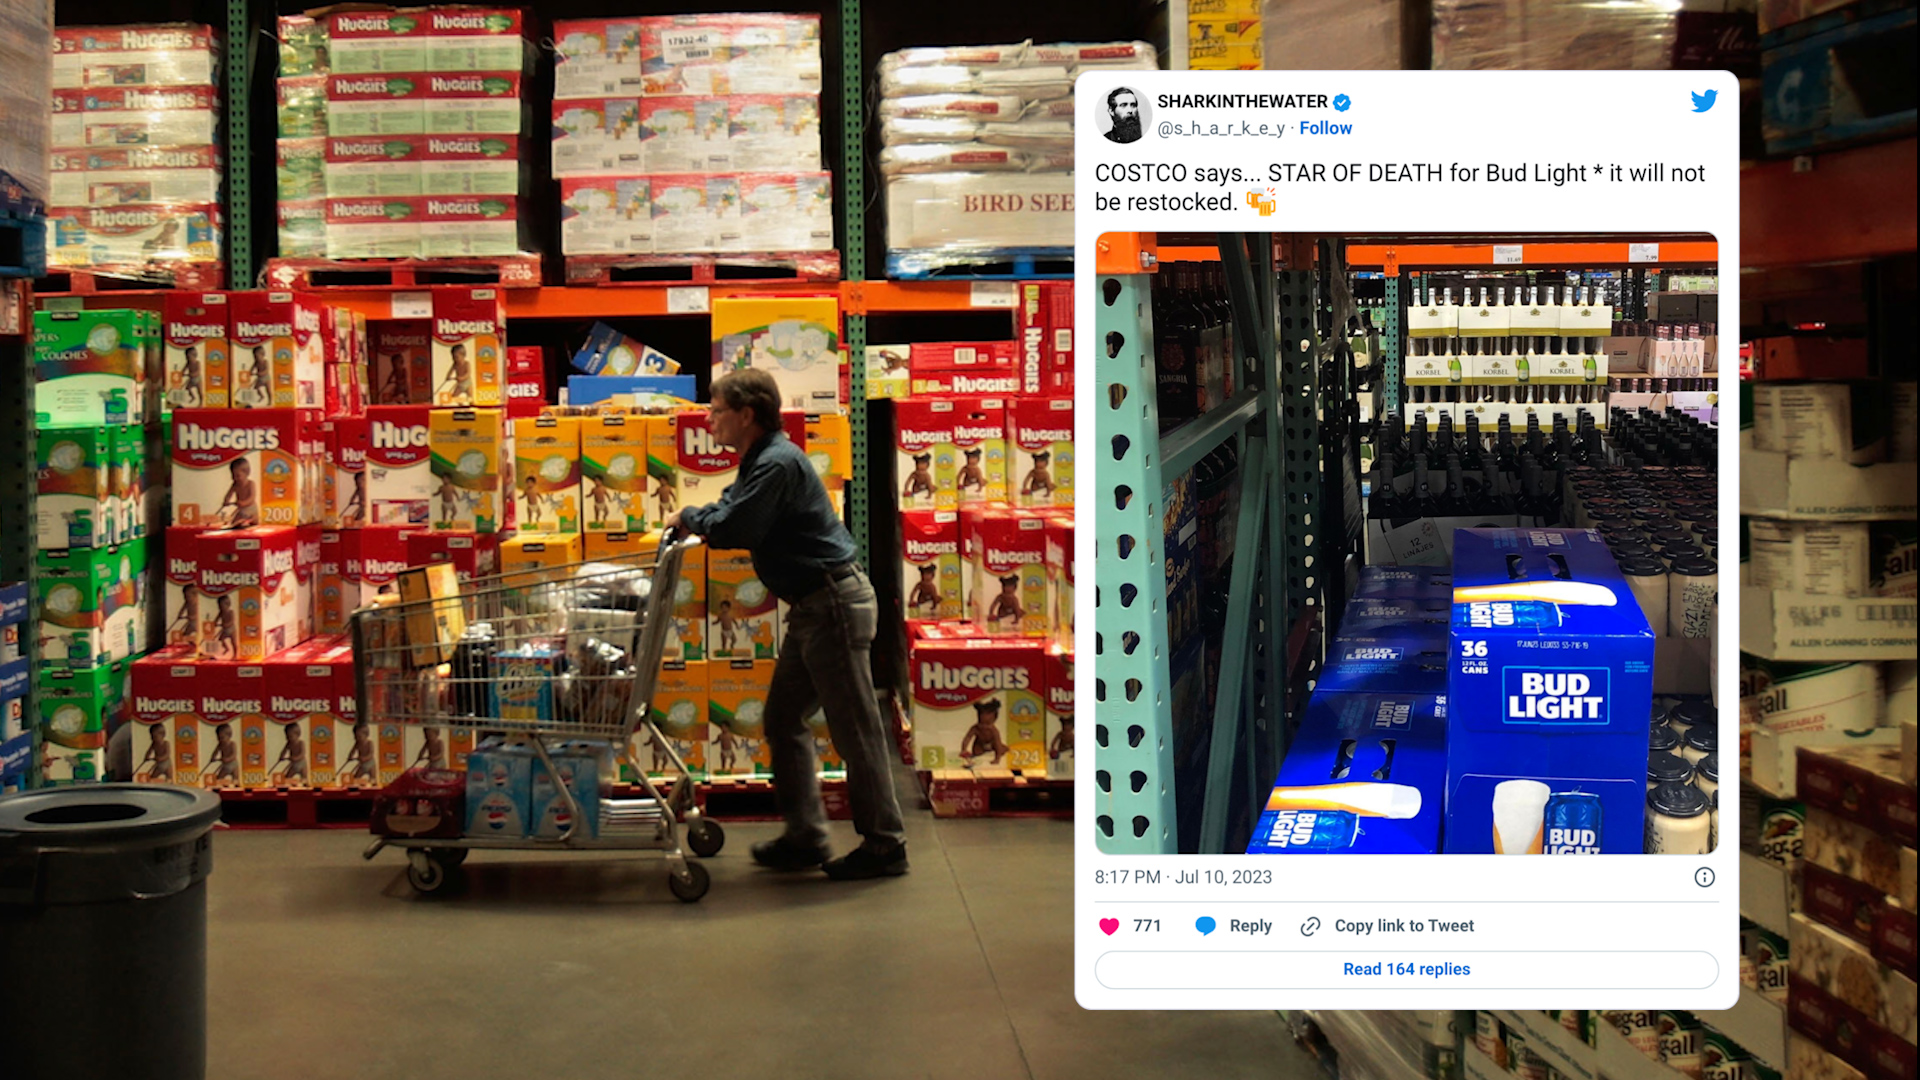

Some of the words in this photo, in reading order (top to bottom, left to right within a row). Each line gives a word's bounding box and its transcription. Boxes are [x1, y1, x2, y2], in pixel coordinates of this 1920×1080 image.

[338, 17, 389, 31] HUGGIES
[433, 15, 485, 29] HUGGIES
[122, 31, 193, 49] HUGGIES
[336, 79, 387, 94] HUGGIES
[432, 77, 484, 91] HUGGIES
[124, 91, 196, 109] HUGGIES
[334, 142, 385, 155] HUGGIES
[429, 140, 481, 154] HUGGIES
[128, 150, 199, 168] HUGGIES
[334, 203, 385, 217] HUGGIES
[428, 201, 480, 214] HUGGIES
[964, 194, 1024, 212] BIRD
[91, 210, 158, 227] HUGGIES
[170, 322, 225, 337] HUGGIES
[237, 322, 292, 337] HUGGIES
[438, 319, 495, 334] HUGGIES
[381, 334, 426, 346] HUGGIES
[41, 351, 88, 361] COUCHES
[645, 353, 666, 373] 3
[1025, 328, 1042, 393] HUGGIES
[1158, 374, 1188, 385] SANGRIA
[1483, 368, 1509, 376] KORBEL
[1550, 368, 1576, 376] KORBEL
[506, 383, 539, 397] GIES
[953, 376, 1017, 392] HUGGIES
[108, 388, 128, 413] 5
[478, 390, 496, 400] 200
[178, 423, 279, 450] HUGGIES
[372, 421, 430, 449] HUG
[902, 430, 952, 443] HUGGIES
[954, 426, 1002, 438] HUGGIES
[1021, 428, 1071, 441] HUGGIES
[183, 506, 193, 521] 4
[264, 507, 293, 522] 200
[74, 509, 92, 535] 5
[1410, 537, 1421, 547] 12
[1529, 531, 1550, 547] LIGHT
[1546, 533, 1565, 545] BUD
[907, 540, 957, 554] HUGGIES
[1403, 542, 1434, 559] LINAJES
[263, 549, 294, 577] HUGGIES
[988, 549, 1042, 564] HUGGIES
[202, 570, 259, 586] HUGGIES
[1470, 602, 1492, 628] LIGHT
[1492, 602, 1514, 626] BUD
[72, 632, 90, 657] 5
[1461, 640, 1488, 657] 36
[1790, 638, 1822, 647] ALLEN
[1824, 638, 1869, 647] CANNING
[241, 645, 260, 656] 200
[921, 662, 1029, 689] HUGGIES
[1462, 667, 1489, 675] CANS
[1521, 672, 1591, 696] BUD
[136, 697, 194, 712] HUGGIES
[202, 697, 261, 712] HUGGIES
[271, 696, 330, 712] HUGGIES
[1509, 695, 1603, 719] LIGHT
[1375, 701, 1396, 728] LIGHT
[1392, 704, 1410, 725] BUD
[929, 749, 938, 764] 3
[1012, 750, 1039, 765] 224
[76, 753, 95, 779] 5
[178, 772, 197, 783] 200
[243, 772, 263, 784] 200
[312, 772, 332, 783] 200
[1267, 810, 1299, 848] LIGHT
[1290, 813, 1317, 845] BUD
[1550, 829, 1596, 846] BUD
